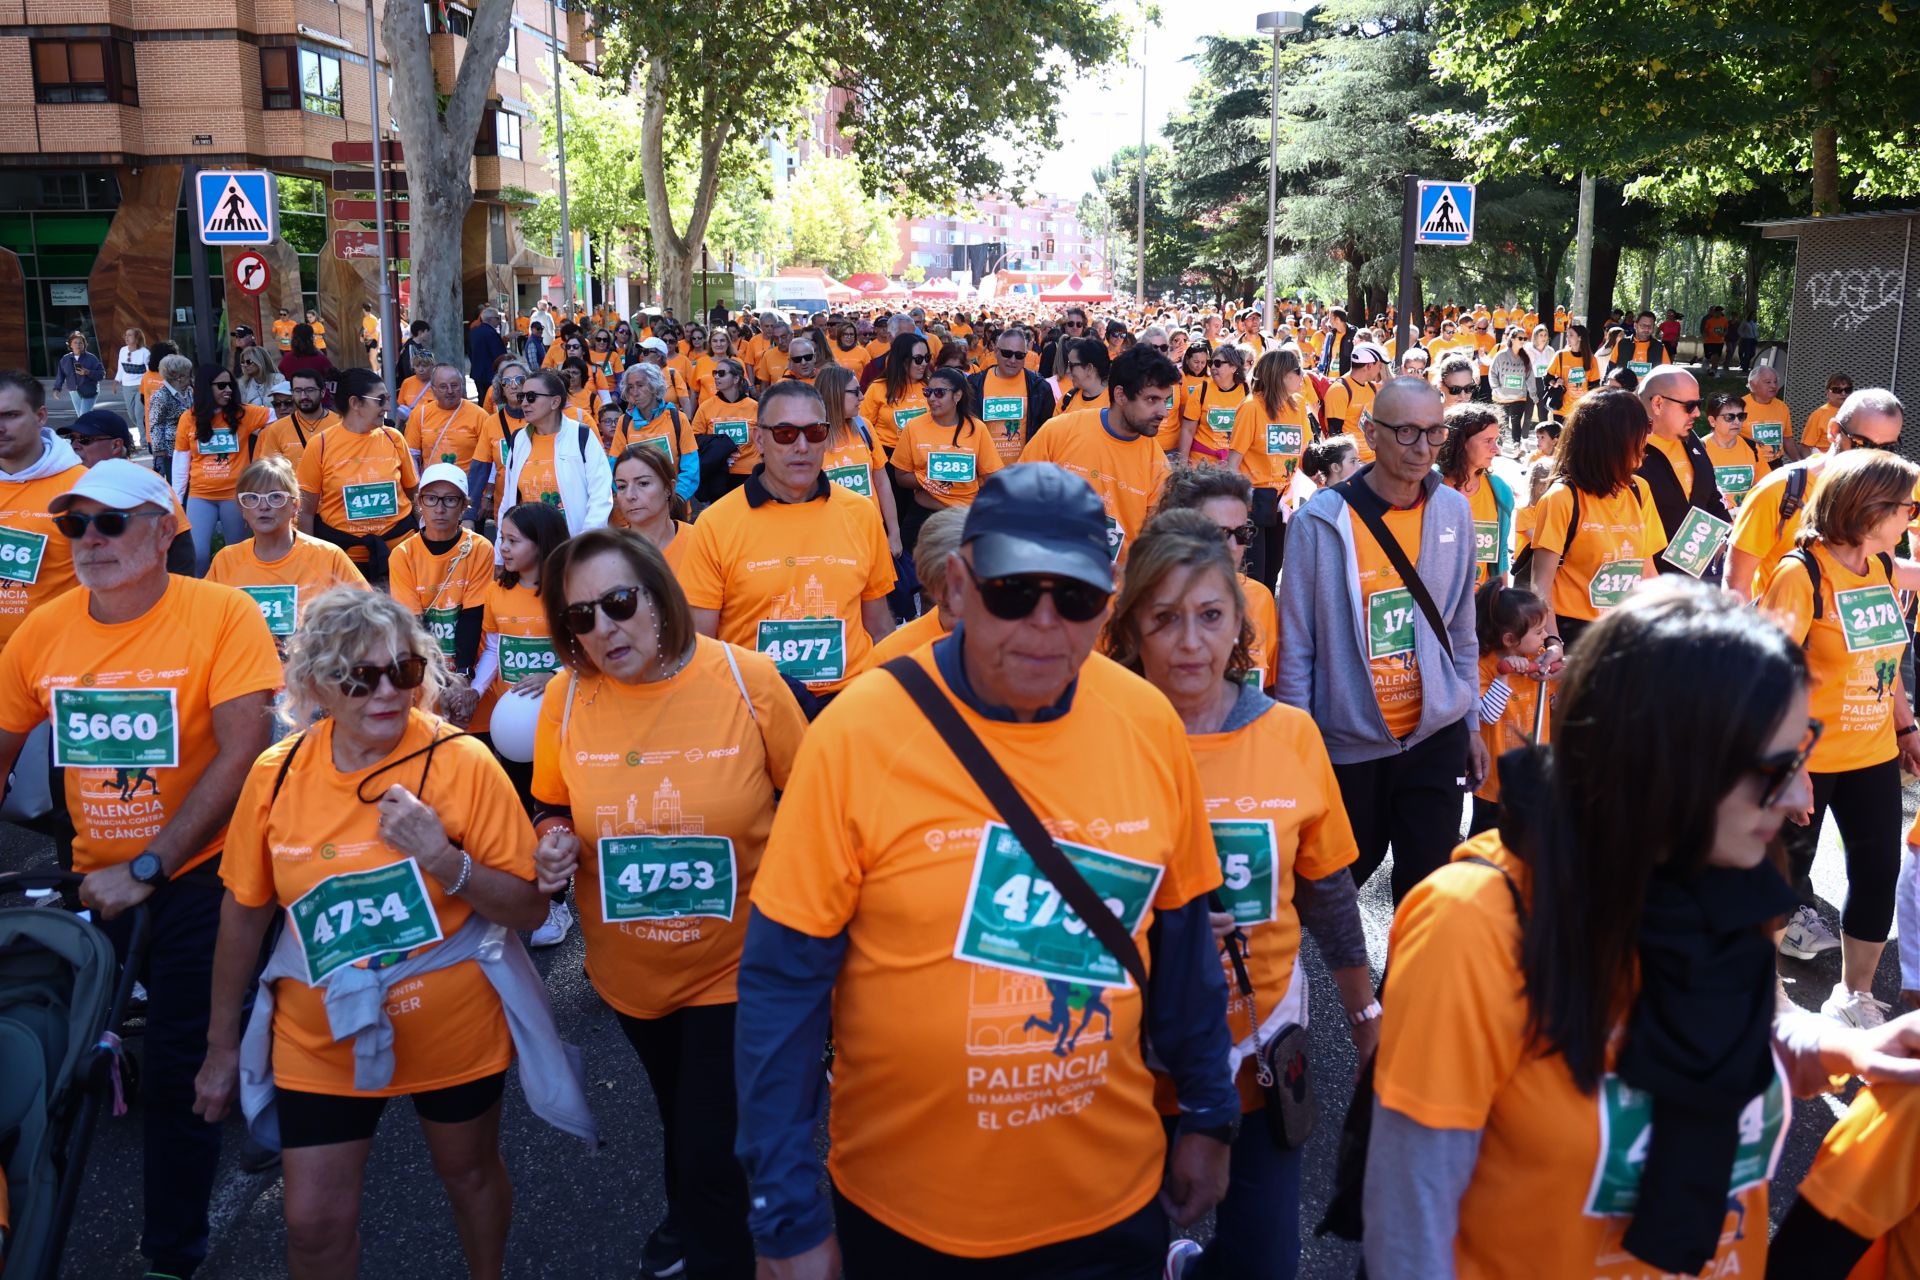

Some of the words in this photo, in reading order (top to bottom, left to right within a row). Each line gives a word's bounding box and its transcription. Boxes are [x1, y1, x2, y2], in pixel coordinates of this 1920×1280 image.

[988, 404, 1018, 413] 2085
[900, 418, 912, 428] 2
[1217, 416, 1230, 424] 79
[1269, 431, 1300, 446] 5063
[934, 462, 968, 472] 6283
[831, 474, 863, 488] 090
[1722, 474, 1745, 484] 775
[352, 493, 390, 508] 4172
[1680, 522, 1712, 564] 1940
[0, 544, 32, 564] 66
[1852, 603, 1897, 630] 2178
[504, 650, 556, 668] 2029
[765, 639, 831, 662] 4877
[69, 712, 158, 740] 5660
[707, 744, 740, 758] repsol
[82, 800, 164, 818] PALENCIA
[90, 829, 102, 840] EL
[104, 825, 162, 840] CÁNCER
[948, 828, 982, 841] oreg
[618, 861, 716, 894] 4753
[313, 892, 410, 944] 4754
[620, 922, 632, 936] EL
[635, 926, 701, 943] CÁNCER
[967, 1050, 1108, 1089] PALENCIA
[968, 1092, 986, 1105] EN
[990, 1088, 1053, 1105] MARCHA
[978, 1110, 1002, 1131] EL
[1007, 1091, 1094, 1128] CÁNCER
